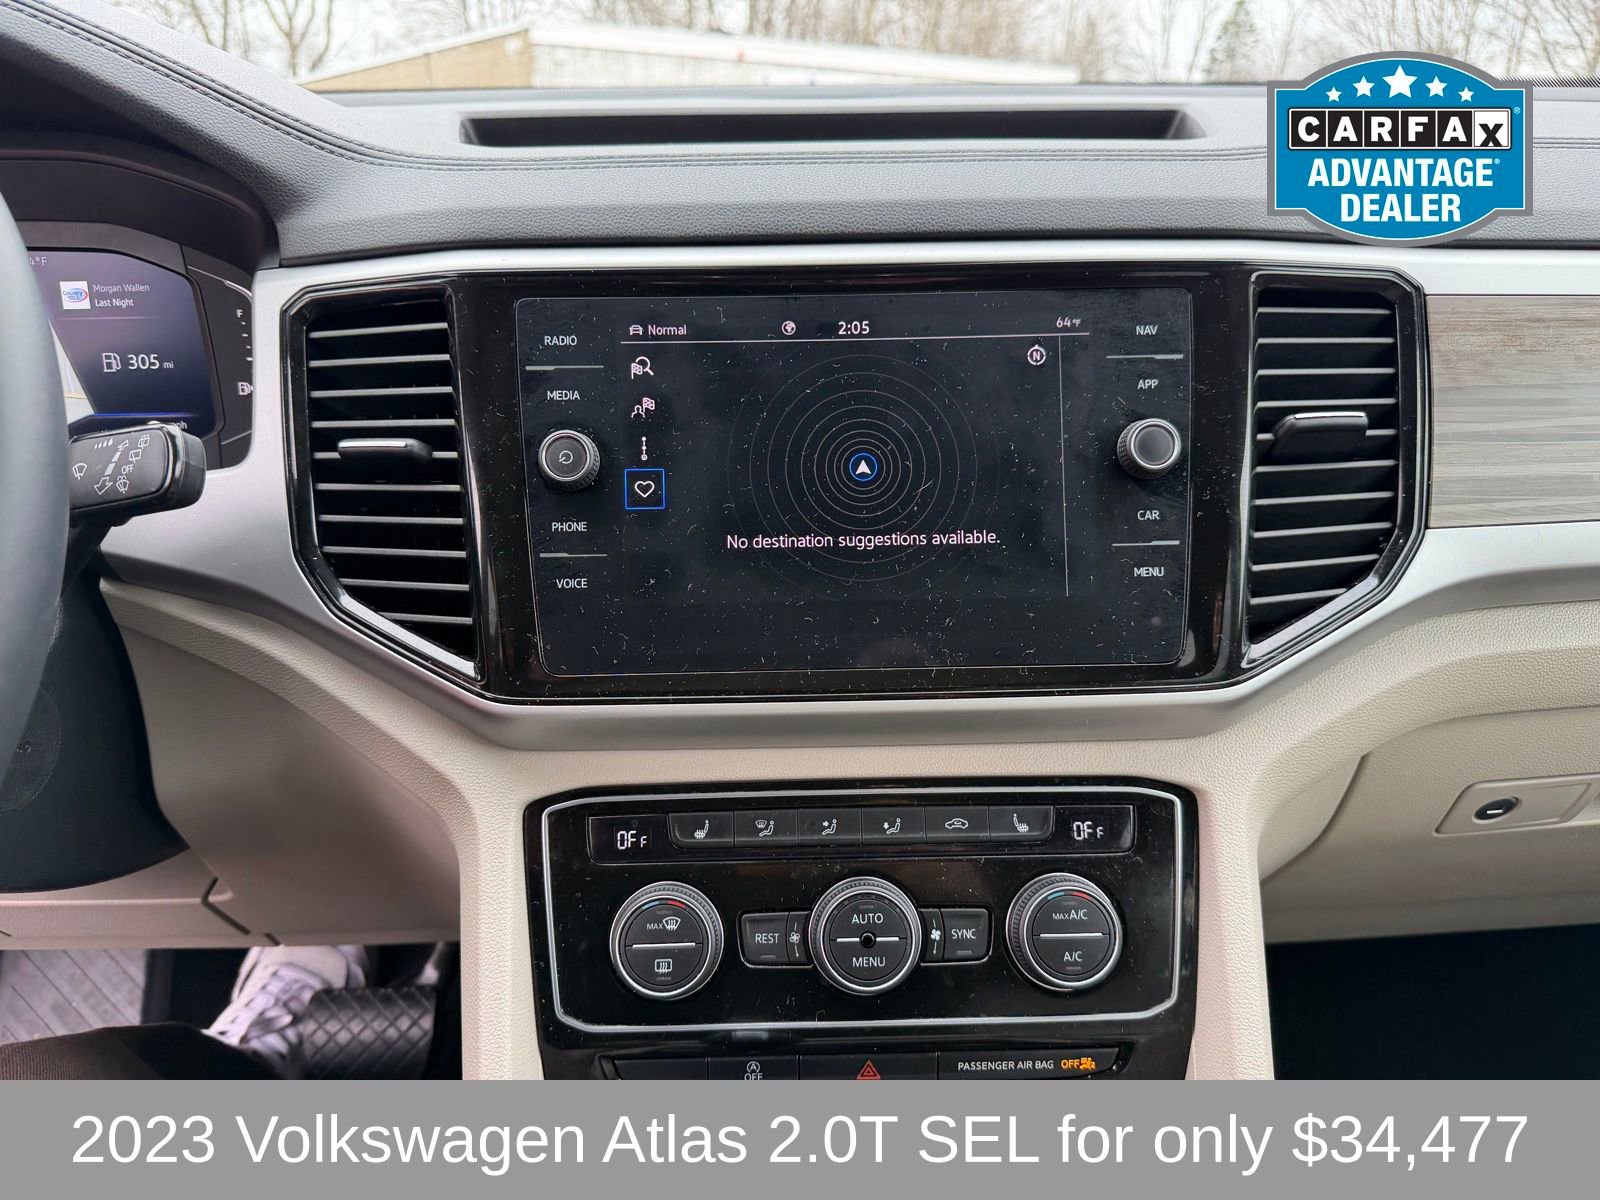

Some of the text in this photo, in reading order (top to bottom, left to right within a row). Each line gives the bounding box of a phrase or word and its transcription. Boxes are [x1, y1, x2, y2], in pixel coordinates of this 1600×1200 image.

[92, 284, 150, 294] Morgan Wallen
[95, 298, 134, 308] Last Night
[648, 324, 687, 336] Normal
[838, 321, 870, 335] 2:05
[1136, 325, 1159, 336] NAV
[544, 335, 578, 346] RADIO
[128, 354, 174, 369] 305 mi
[1137, 379, 1159, 390] APP
[547, 391, 580, 401] MEDIA
[121, 463, 135, 475] OFF
[1137, 510, 1160, 520] CAR
[551, 521, 588, 532] PHONE
[727, 529, 1000, 550] No destination suggestions available.
[1133, 567, 1164, 577] MENU
[556, 578, 588, 589] VOICE
[852, 912, 884, 924] AUTO
[755, 933, 780, 944] REST
[951, 929, 977, 940] SYNC
[852, 956, 886, 968] MENU
[1063, 951, 1083, 963] A/C
[957, 1059, 1080, 1071] PASSENGER AIR BAG OFF
[744, 1072, 763, 1080] OFF
